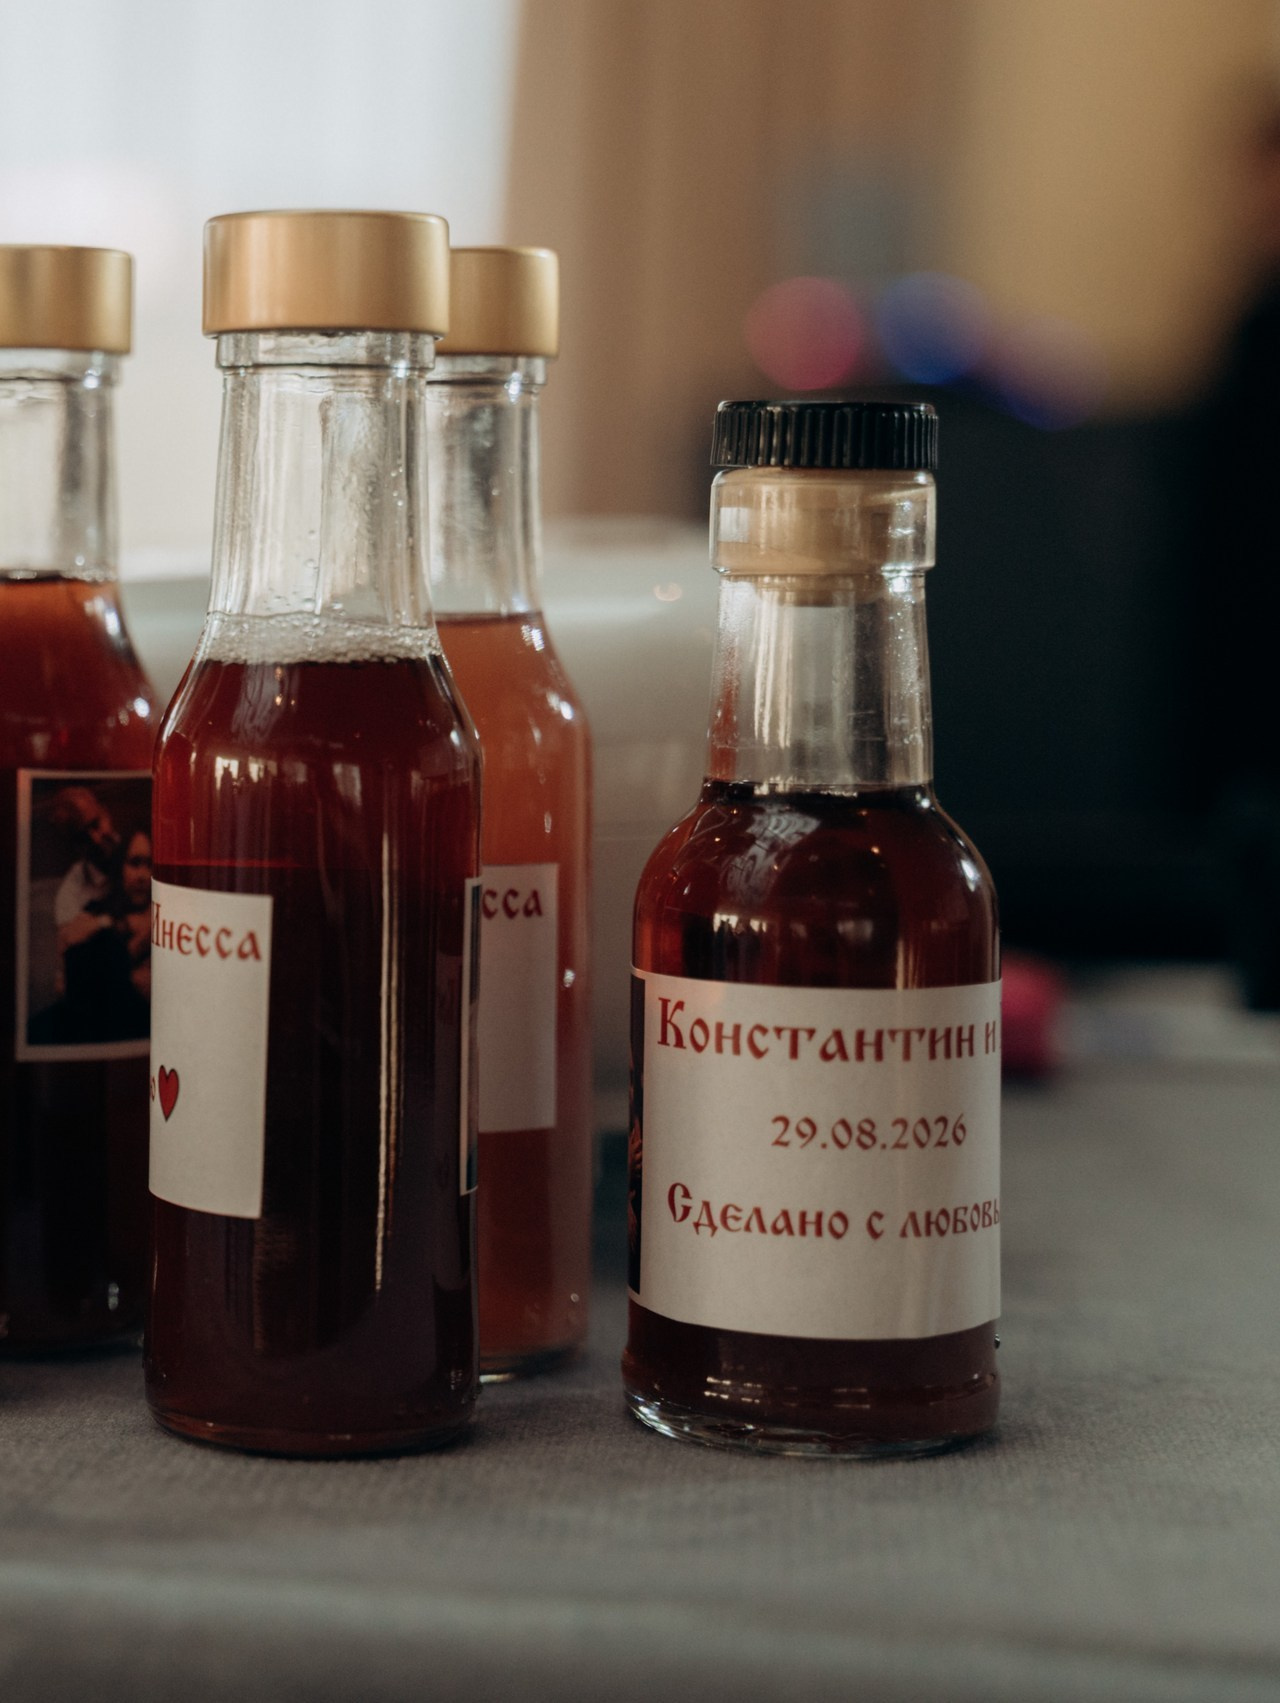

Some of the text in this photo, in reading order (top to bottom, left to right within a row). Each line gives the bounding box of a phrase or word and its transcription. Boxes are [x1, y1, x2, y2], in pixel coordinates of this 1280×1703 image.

[657, 997, 996, 1062] Константин и
[770, 1112, 967, 1150] 29.08.2026
[667, 1182, 849, 1240] Сделано
[866, 1210, 885, 1240] с
